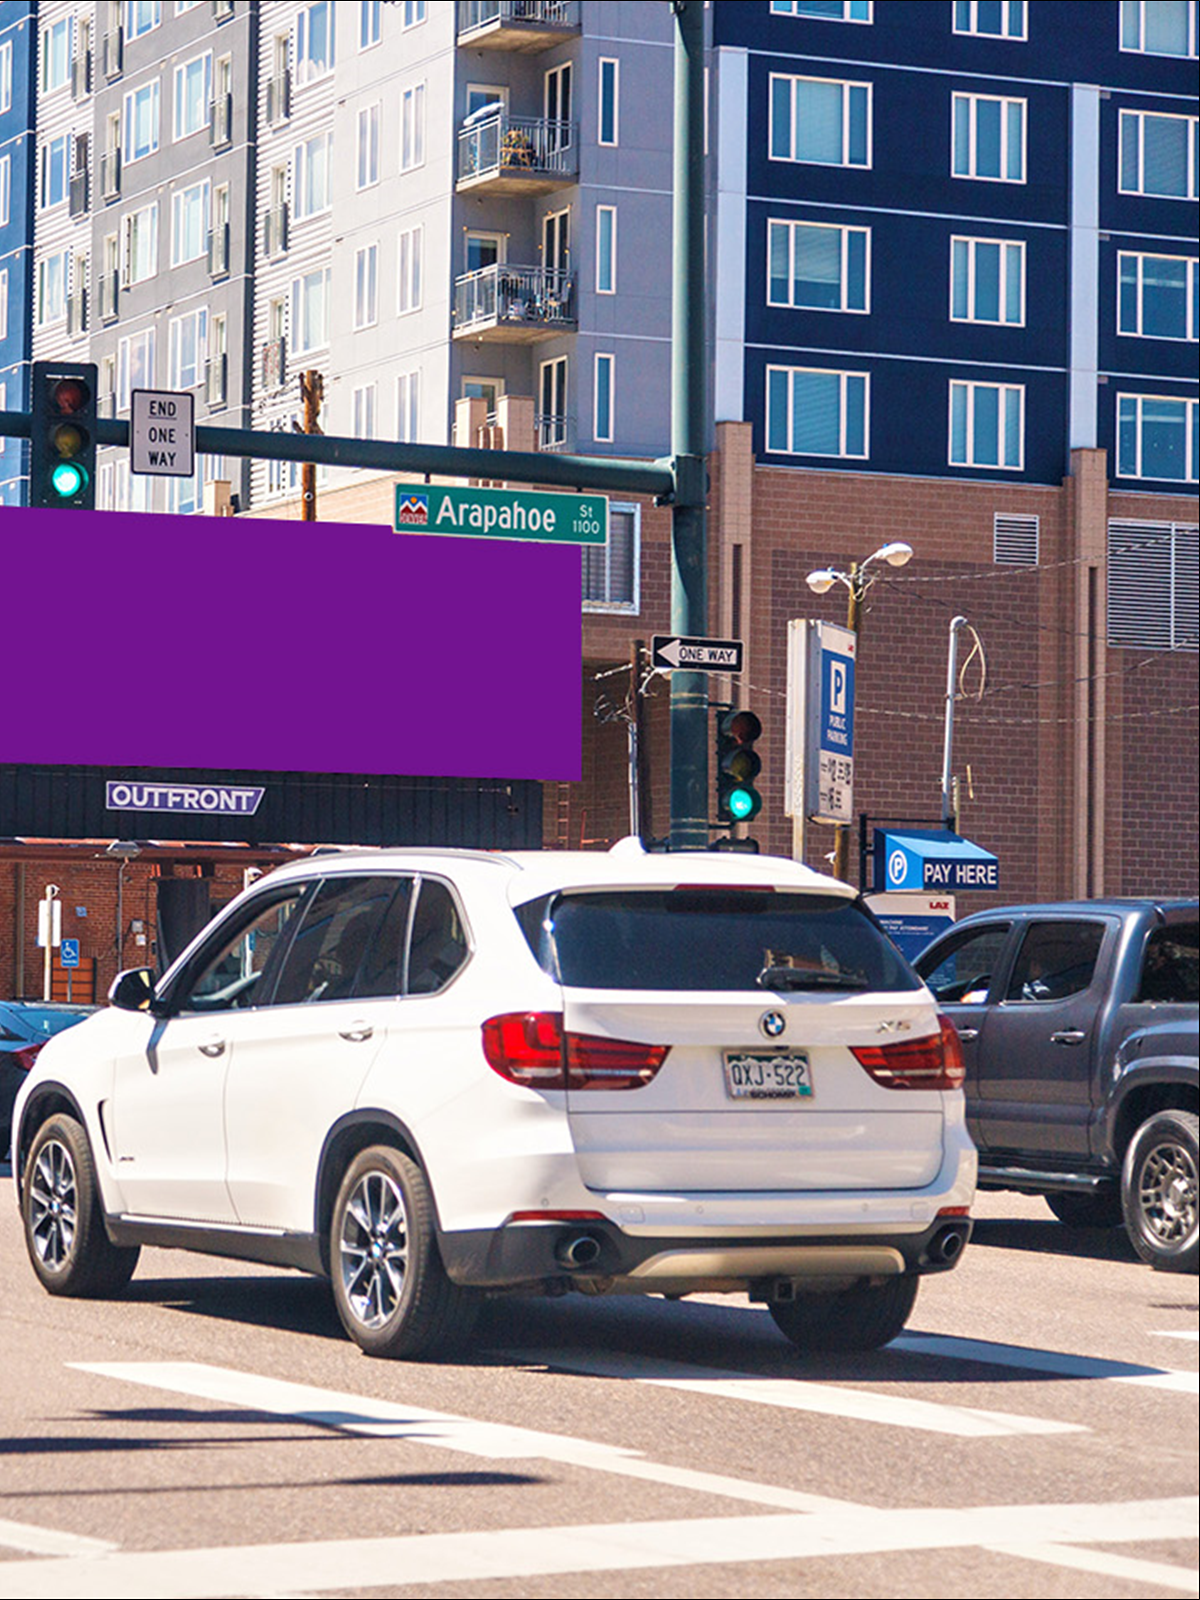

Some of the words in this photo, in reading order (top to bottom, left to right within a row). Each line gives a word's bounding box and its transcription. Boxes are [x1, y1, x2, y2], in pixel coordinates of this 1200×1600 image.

[149, 400, 176, 417] END
[148, 427, 176, 443] ONE
[148, 451, 176, 467] WAY
[435, 495, 556, 533] Arapahoe
[579, 504, 593, 518] St
[573, 520, 600, 534] 1100
[679, 647, 704, 660] ONE
[708, 650, 733, 662] WAY
[834, 668, 843, 706] P
[112, 785, 255, 811] OUTFRONT
[924, 863, 951, 883] PAY
[956, 865, 997, 884] HERE
[732, 1064, 806, 1086] QXJ-522
